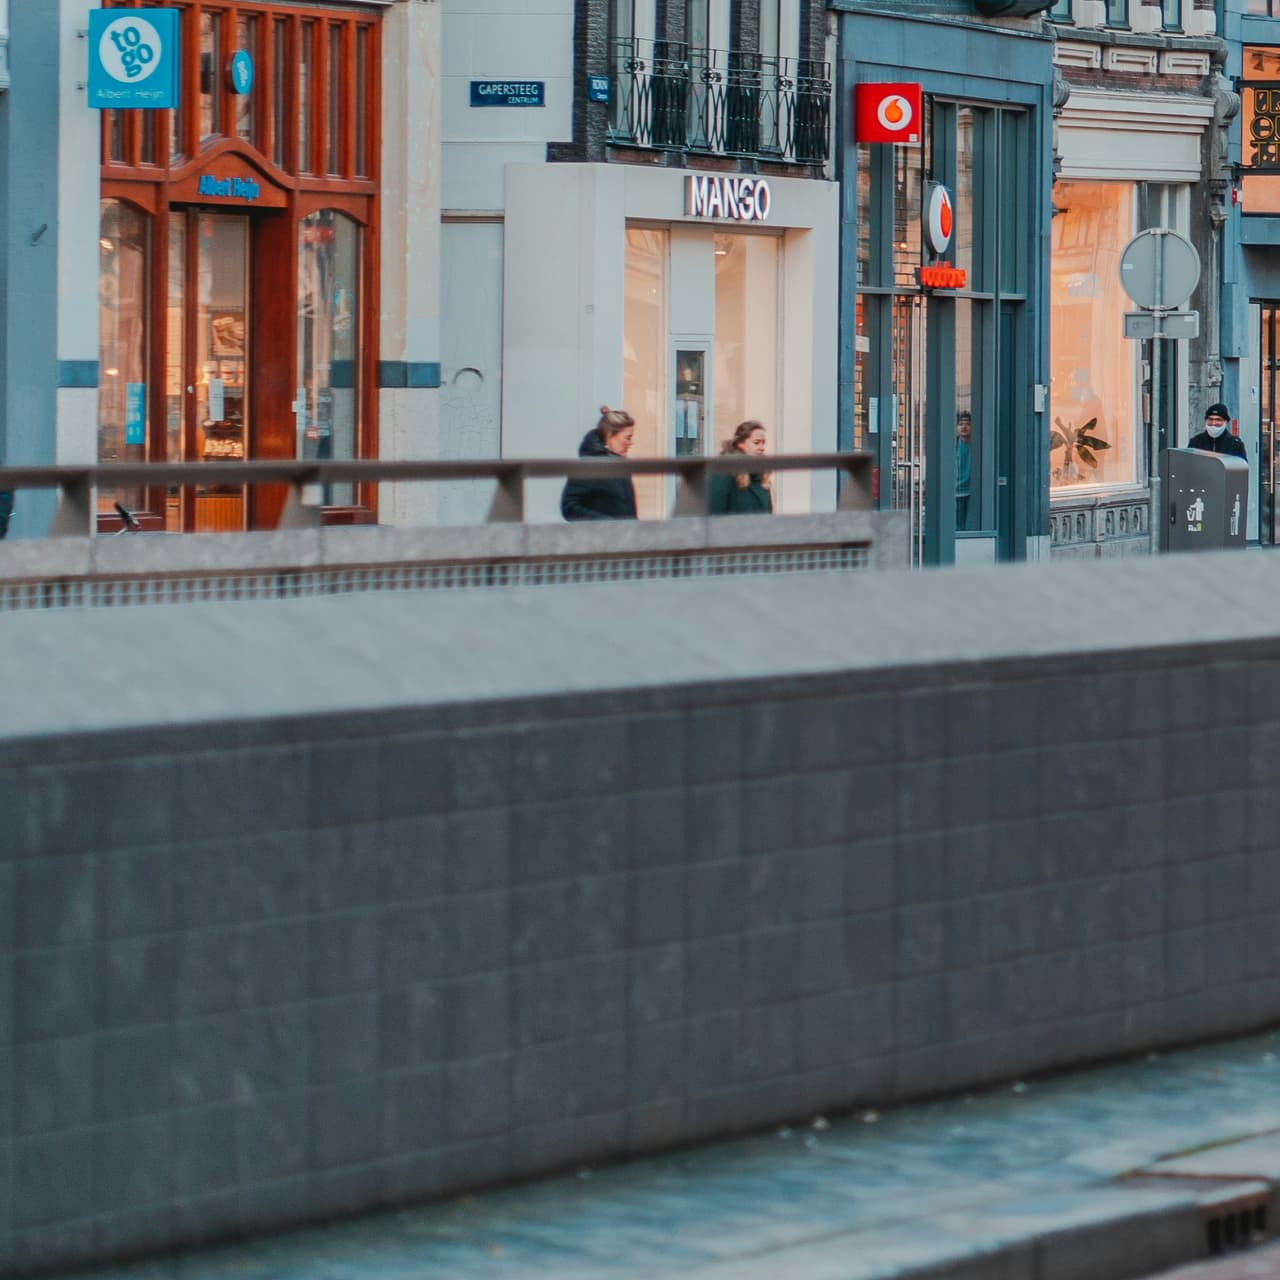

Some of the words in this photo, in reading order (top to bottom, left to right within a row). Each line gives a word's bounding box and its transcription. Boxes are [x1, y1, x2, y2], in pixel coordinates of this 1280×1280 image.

[109, 25, 141, 53] to
[120, 43, 154, 78] go
[478, 83, 539, 95] GAPERSTEEG
[507, 96, 539, 105] CENTRUM
[688, 175, 771, 220] MANGO
